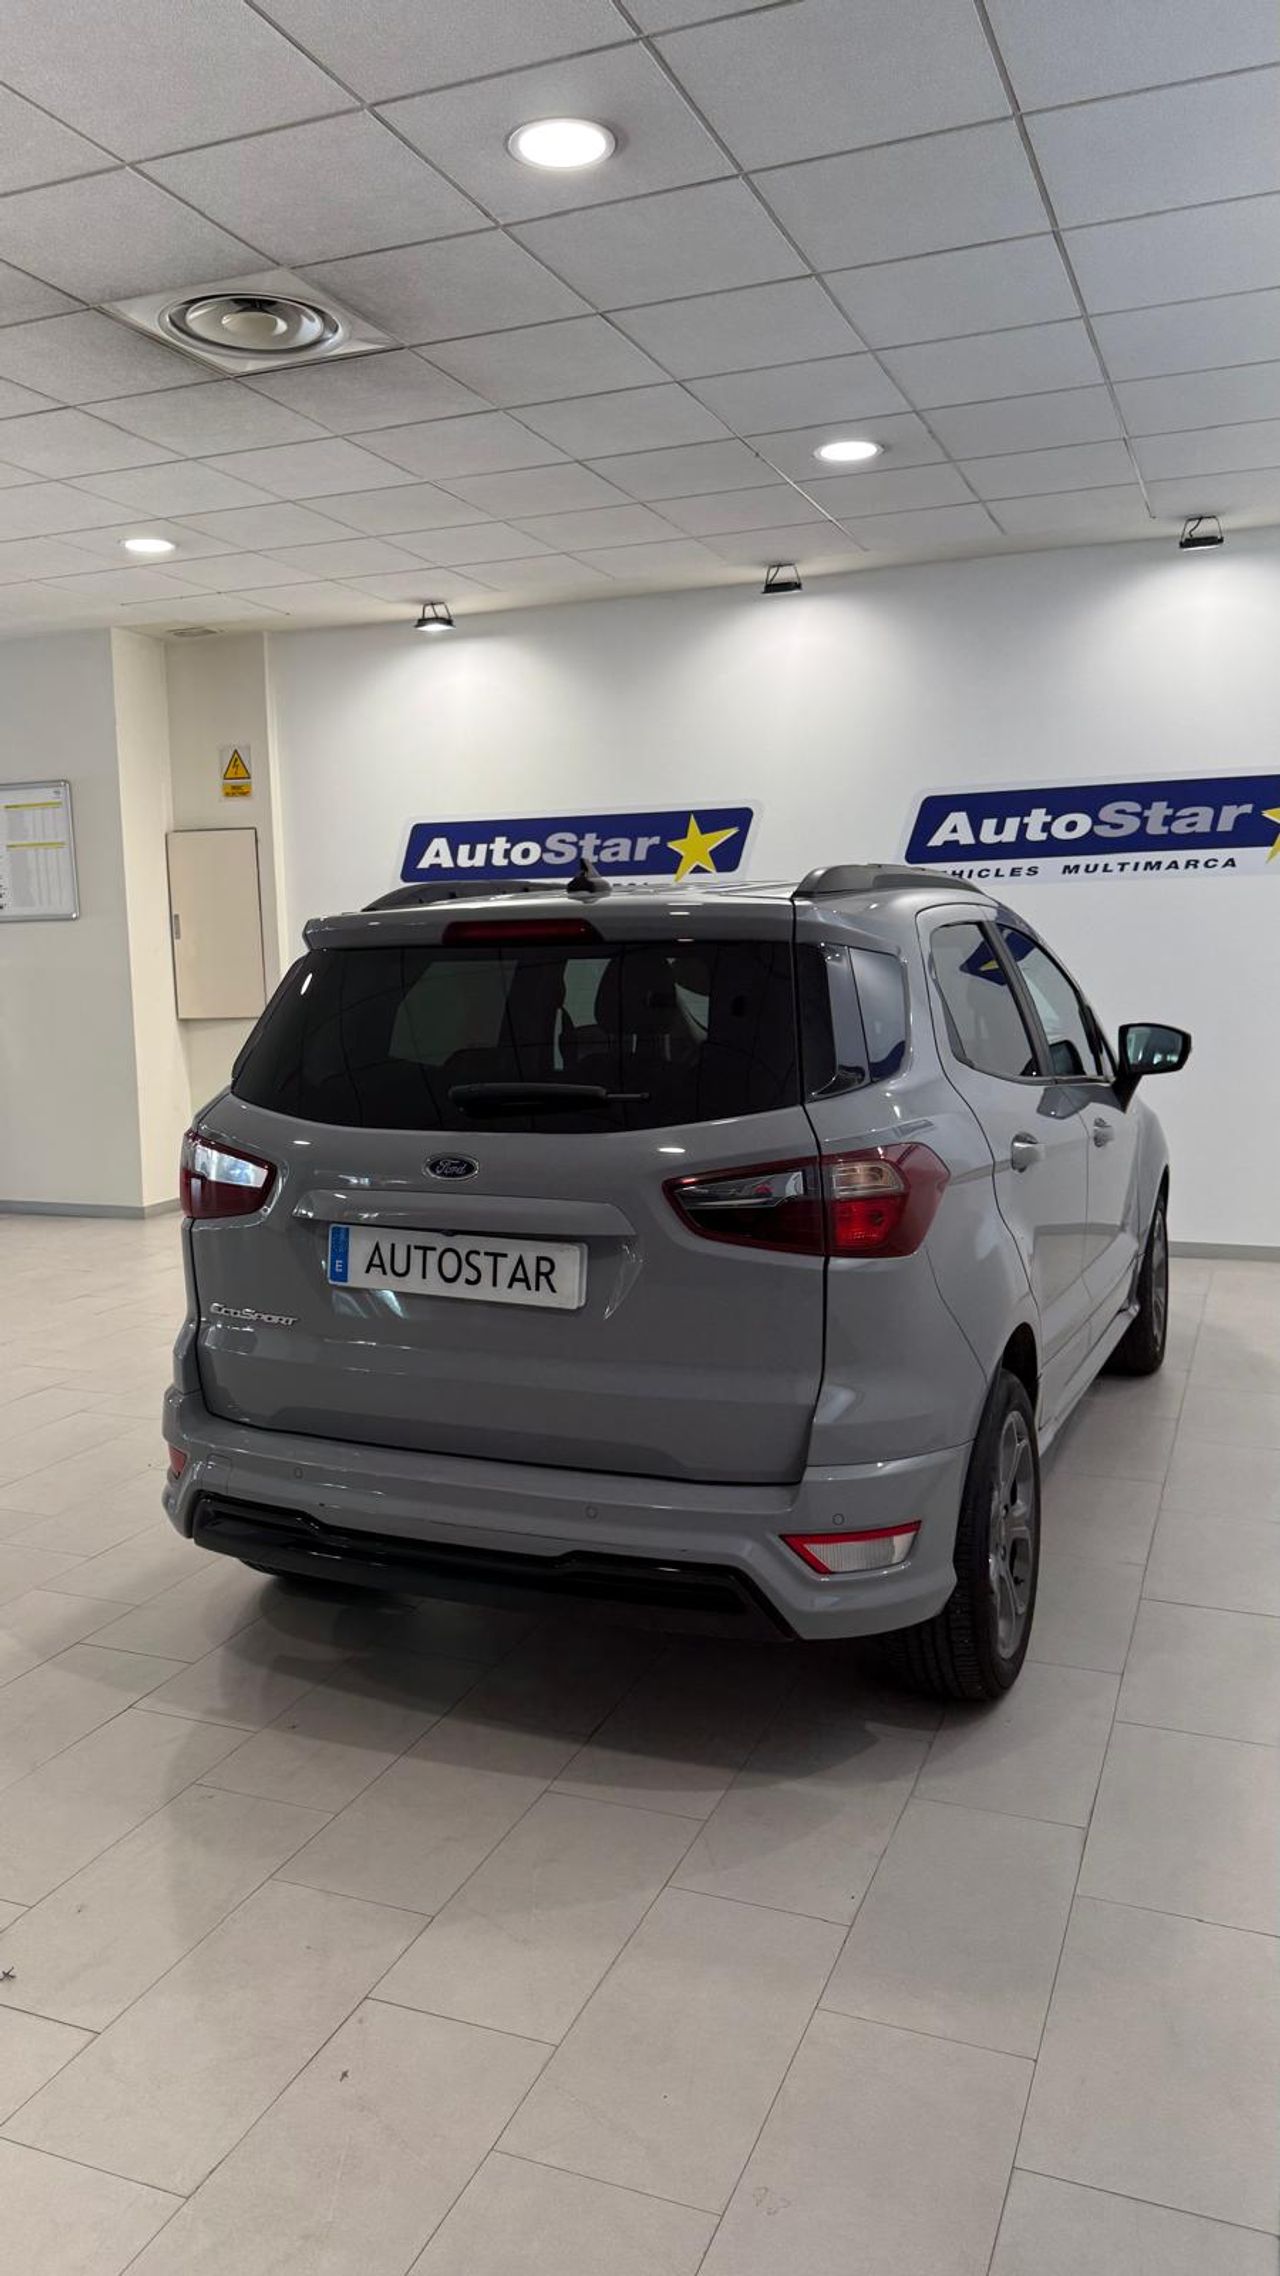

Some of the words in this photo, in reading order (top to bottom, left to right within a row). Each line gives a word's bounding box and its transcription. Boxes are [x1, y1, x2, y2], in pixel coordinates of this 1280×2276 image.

[925, 800, 1253, 848] AutoStar
[416, 832, 661, 869] AutoStar
[943, 865, 1040, 879] HICLES
[1062, 857, 1238, 875] MULTIMARCA
[434, 1158, 469, 1176] Ford
[334, 1259, 344, 1273] E
[364, 1240, 557, 1294] AUTOSTAR
